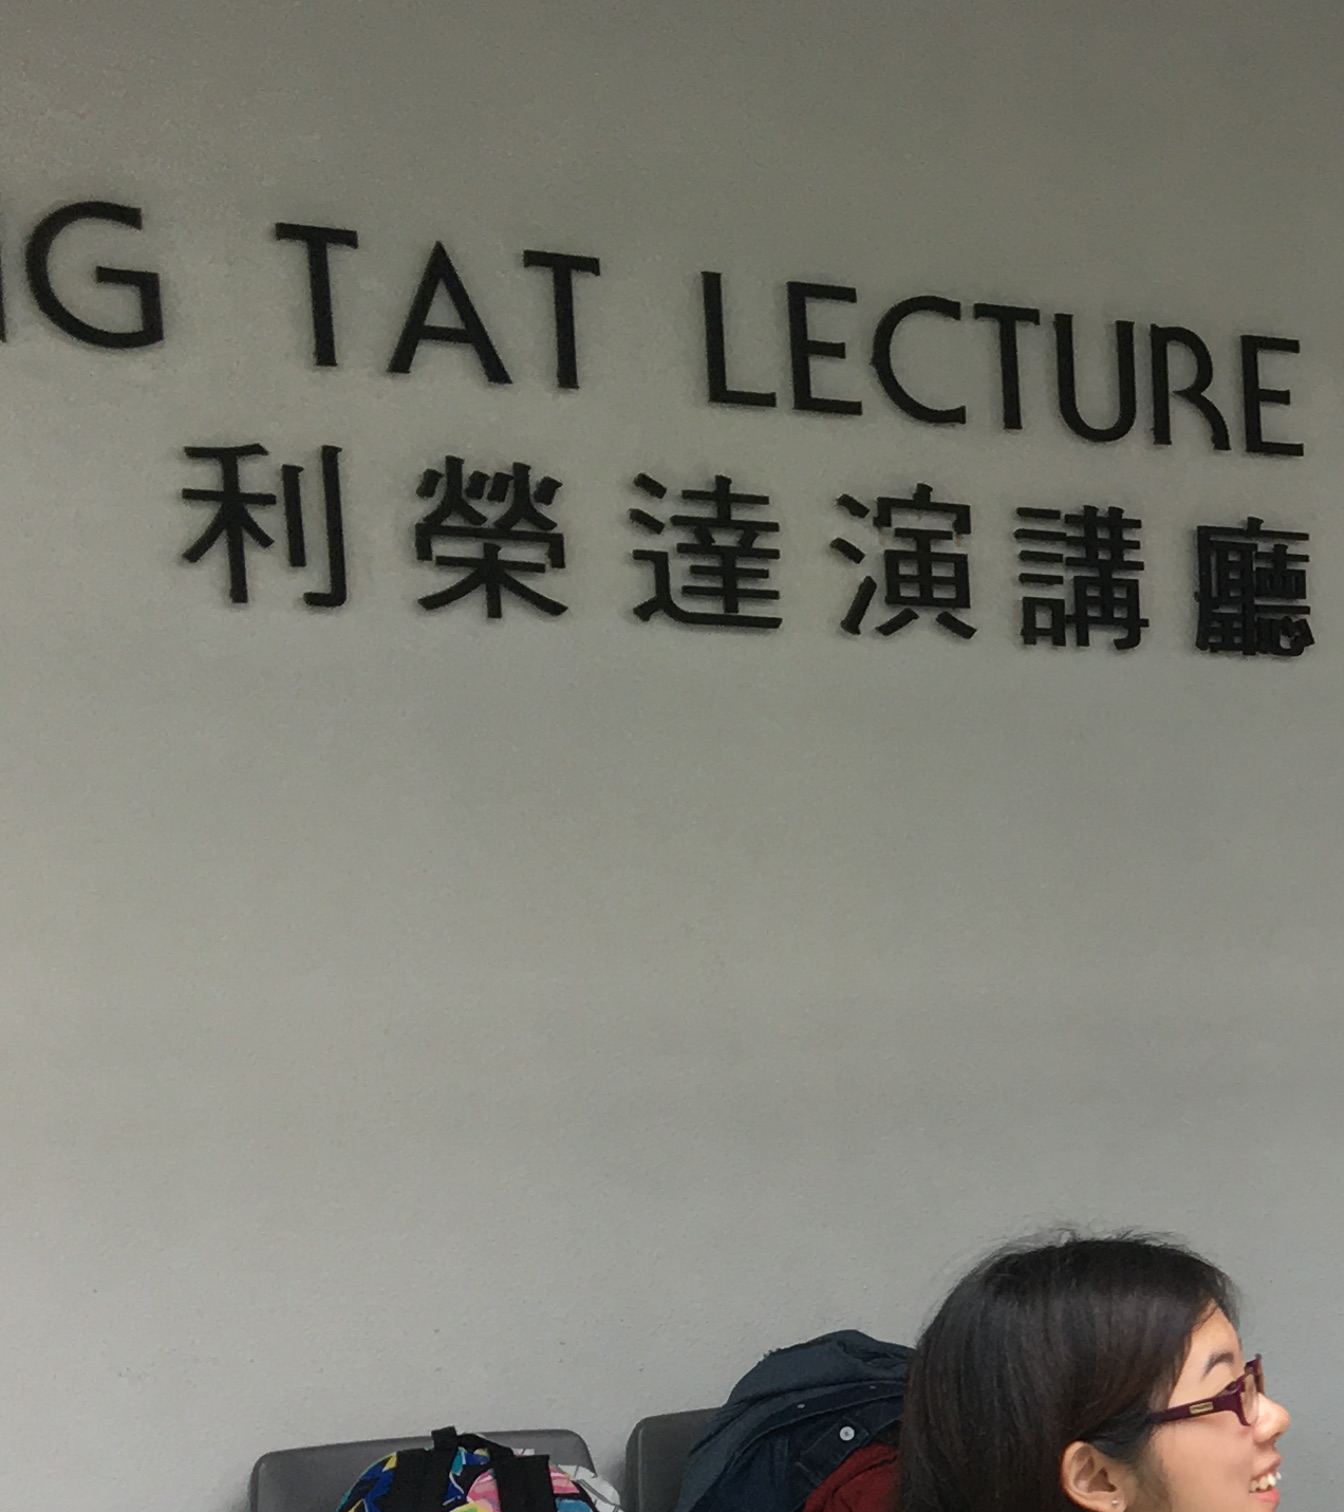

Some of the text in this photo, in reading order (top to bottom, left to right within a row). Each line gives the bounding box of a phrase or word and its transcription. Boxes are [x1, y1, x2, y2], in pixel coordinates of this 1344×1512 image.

[0, 200, 1306, 459] G TAT LECTURE
[180, 443, 1314, 659] 利榮達演講廳
